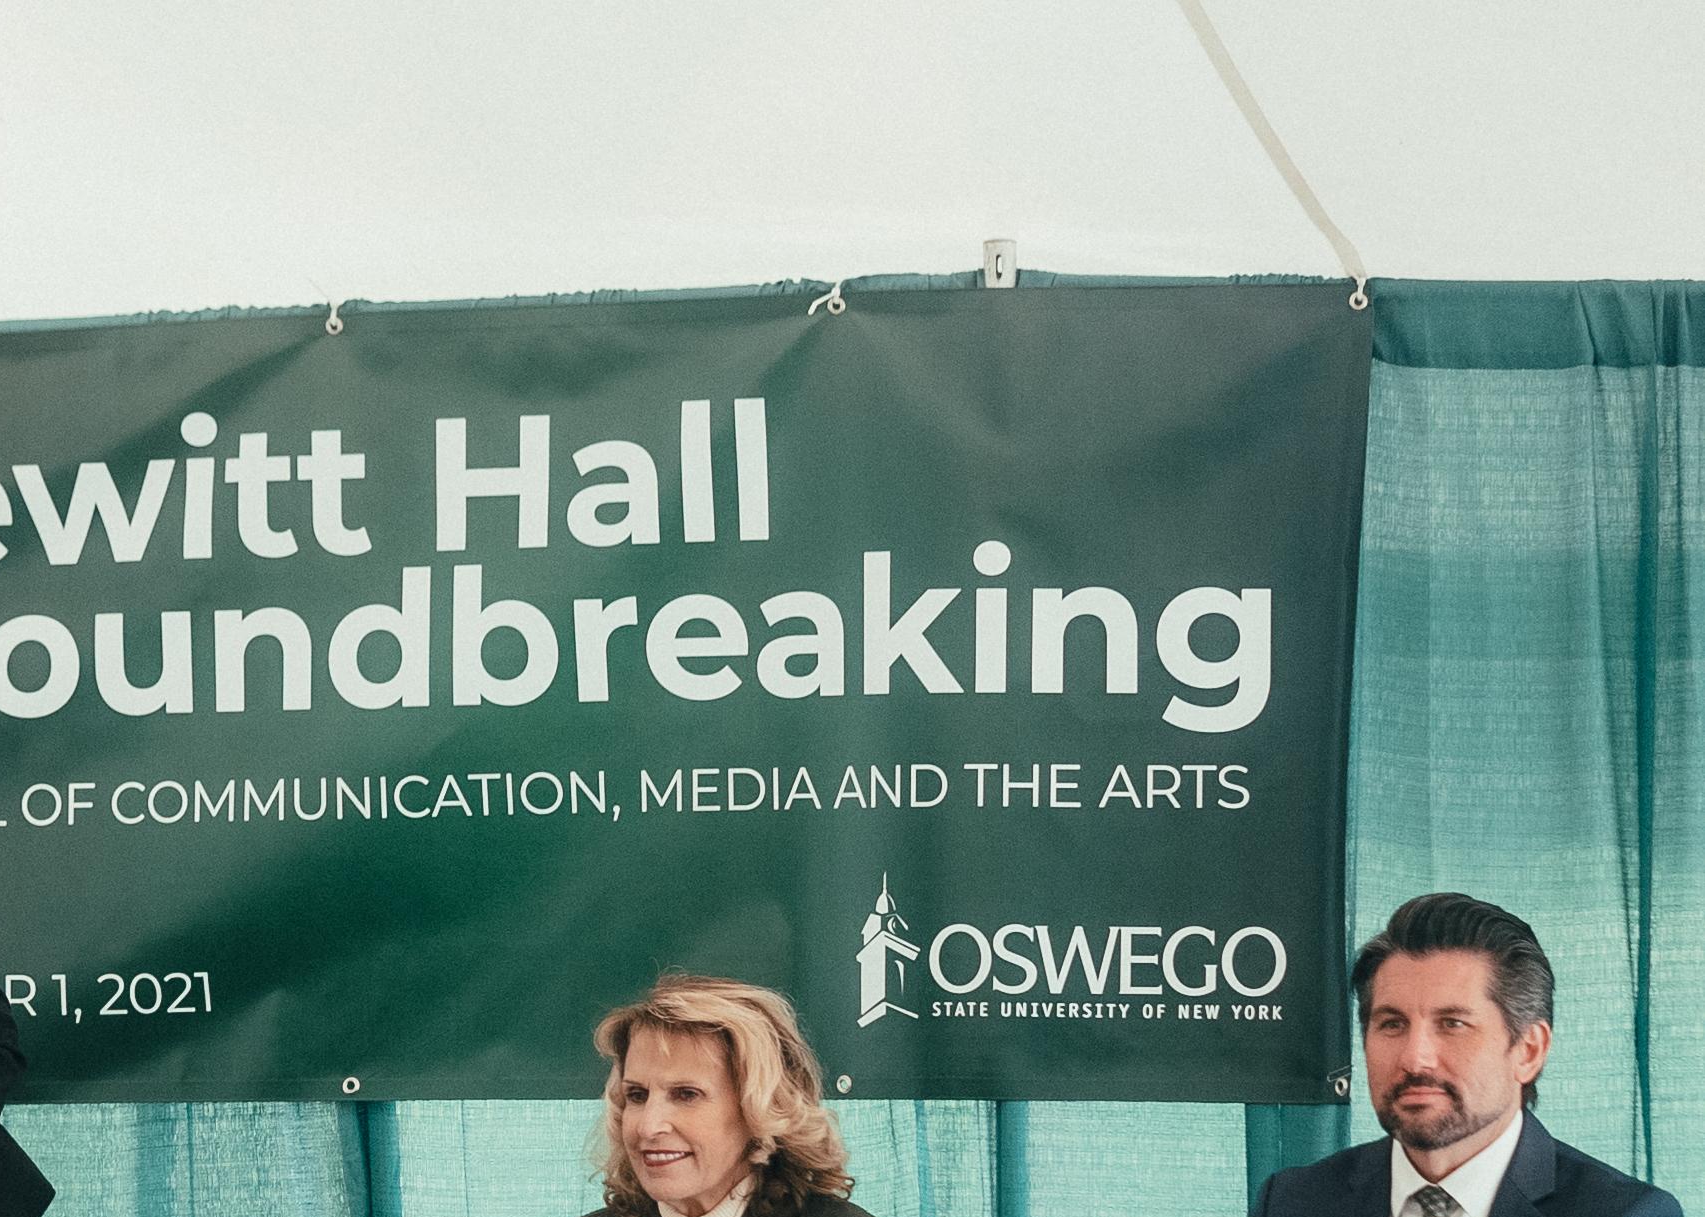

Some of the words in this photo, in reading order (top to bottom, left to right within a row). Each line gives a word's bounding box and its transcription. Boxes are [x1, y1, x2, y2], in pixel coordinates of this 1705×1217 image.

[435, 397, 770, 552] Hall
[21, 782, 96, 827] OF
[111, 767, 622, 824] COMMUNICATION,
[640, 766, 822, 813] MEDIA
[833, 764, 948, 810] AND
[963, 763, 1082, 808] THE
[1098, 764, 1250, 809] ARTS
[928, 923, 1287, 997] OSWEGO
[51, 973, 83, 1024] 1,
[97, 971, 213, 1015] 2021
[932, 1001, 989, 1017] STATE
[1000, 1001, 1130, 1019] UNIVERSITY
[1142, 1003, 1166, 1019] OF
[1178, 1004, 1220, 1020] NEW
[1231, 1004, 1283, 1020] YORK
